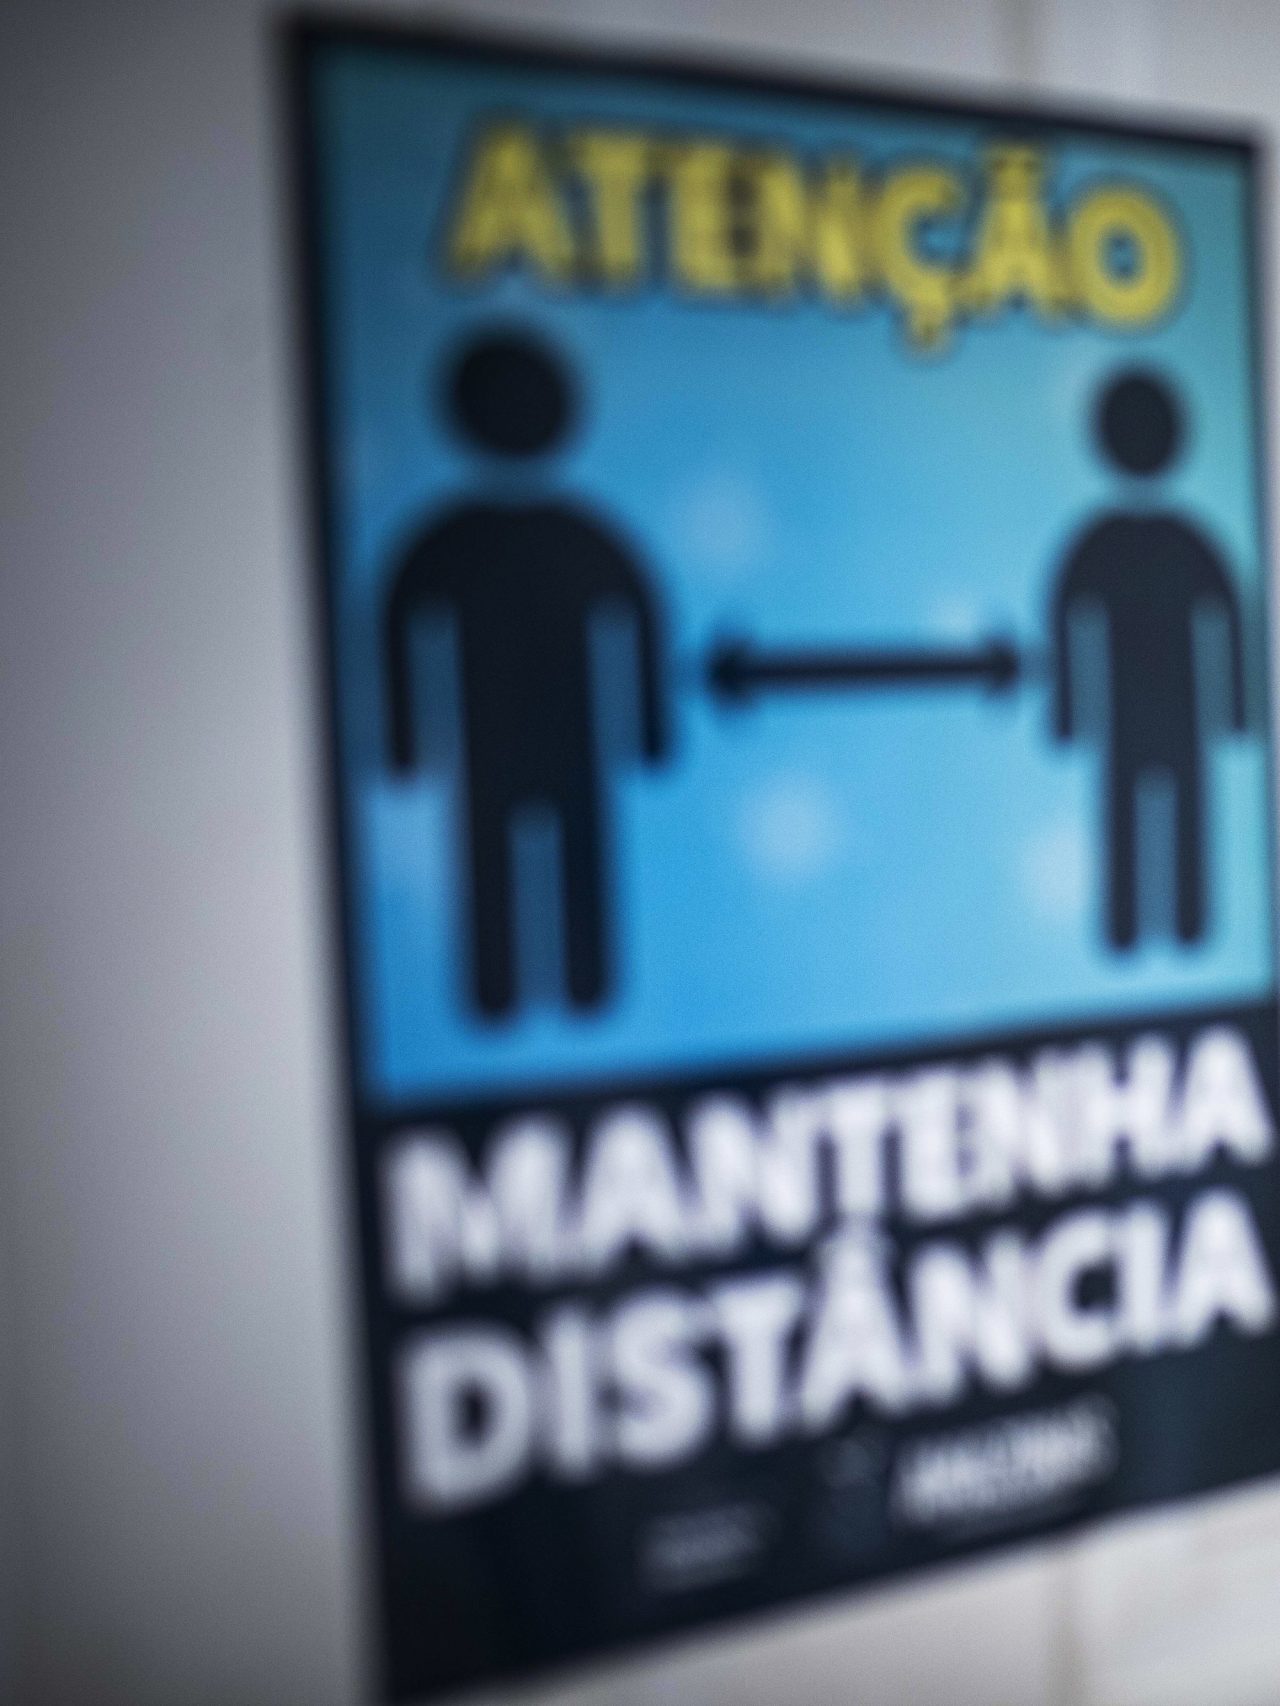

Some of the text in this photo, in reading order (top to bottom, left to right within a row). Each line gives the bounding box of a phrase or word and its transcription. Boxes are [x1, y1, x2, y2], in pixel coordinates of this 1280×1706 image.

[445, 122, 1186, 348] ATENÇÃO
[383, 1026, 1276, 1302] MANTENHA
[402, 1190, 1277, 1516] DISTÂNCIA
